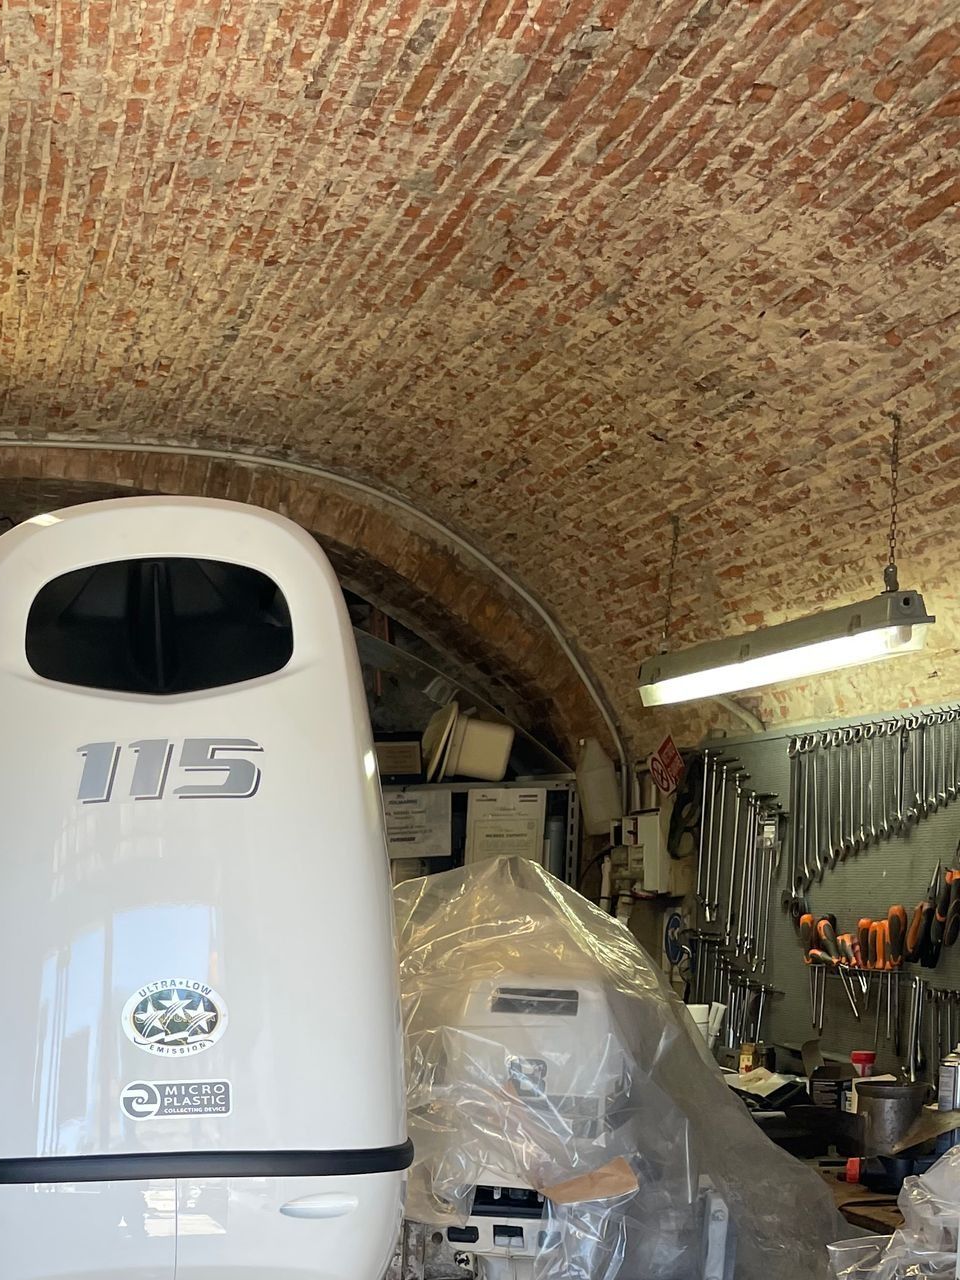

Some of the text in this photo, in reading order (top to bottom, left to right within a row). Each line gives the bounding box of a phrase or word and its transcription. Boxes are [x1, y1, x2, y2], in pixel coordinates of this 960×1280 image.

[76, 738, 264, 804] 115
[138, 979, 212, 998] ULTRA LOW
[149, 1042, 206, 1055] EMISSION
[164, 1084, 226, 1096] MICRO
[164, 1095, 226, 1106] PLASTIC
[164, 1106, 203, 1114] COLLECTING
